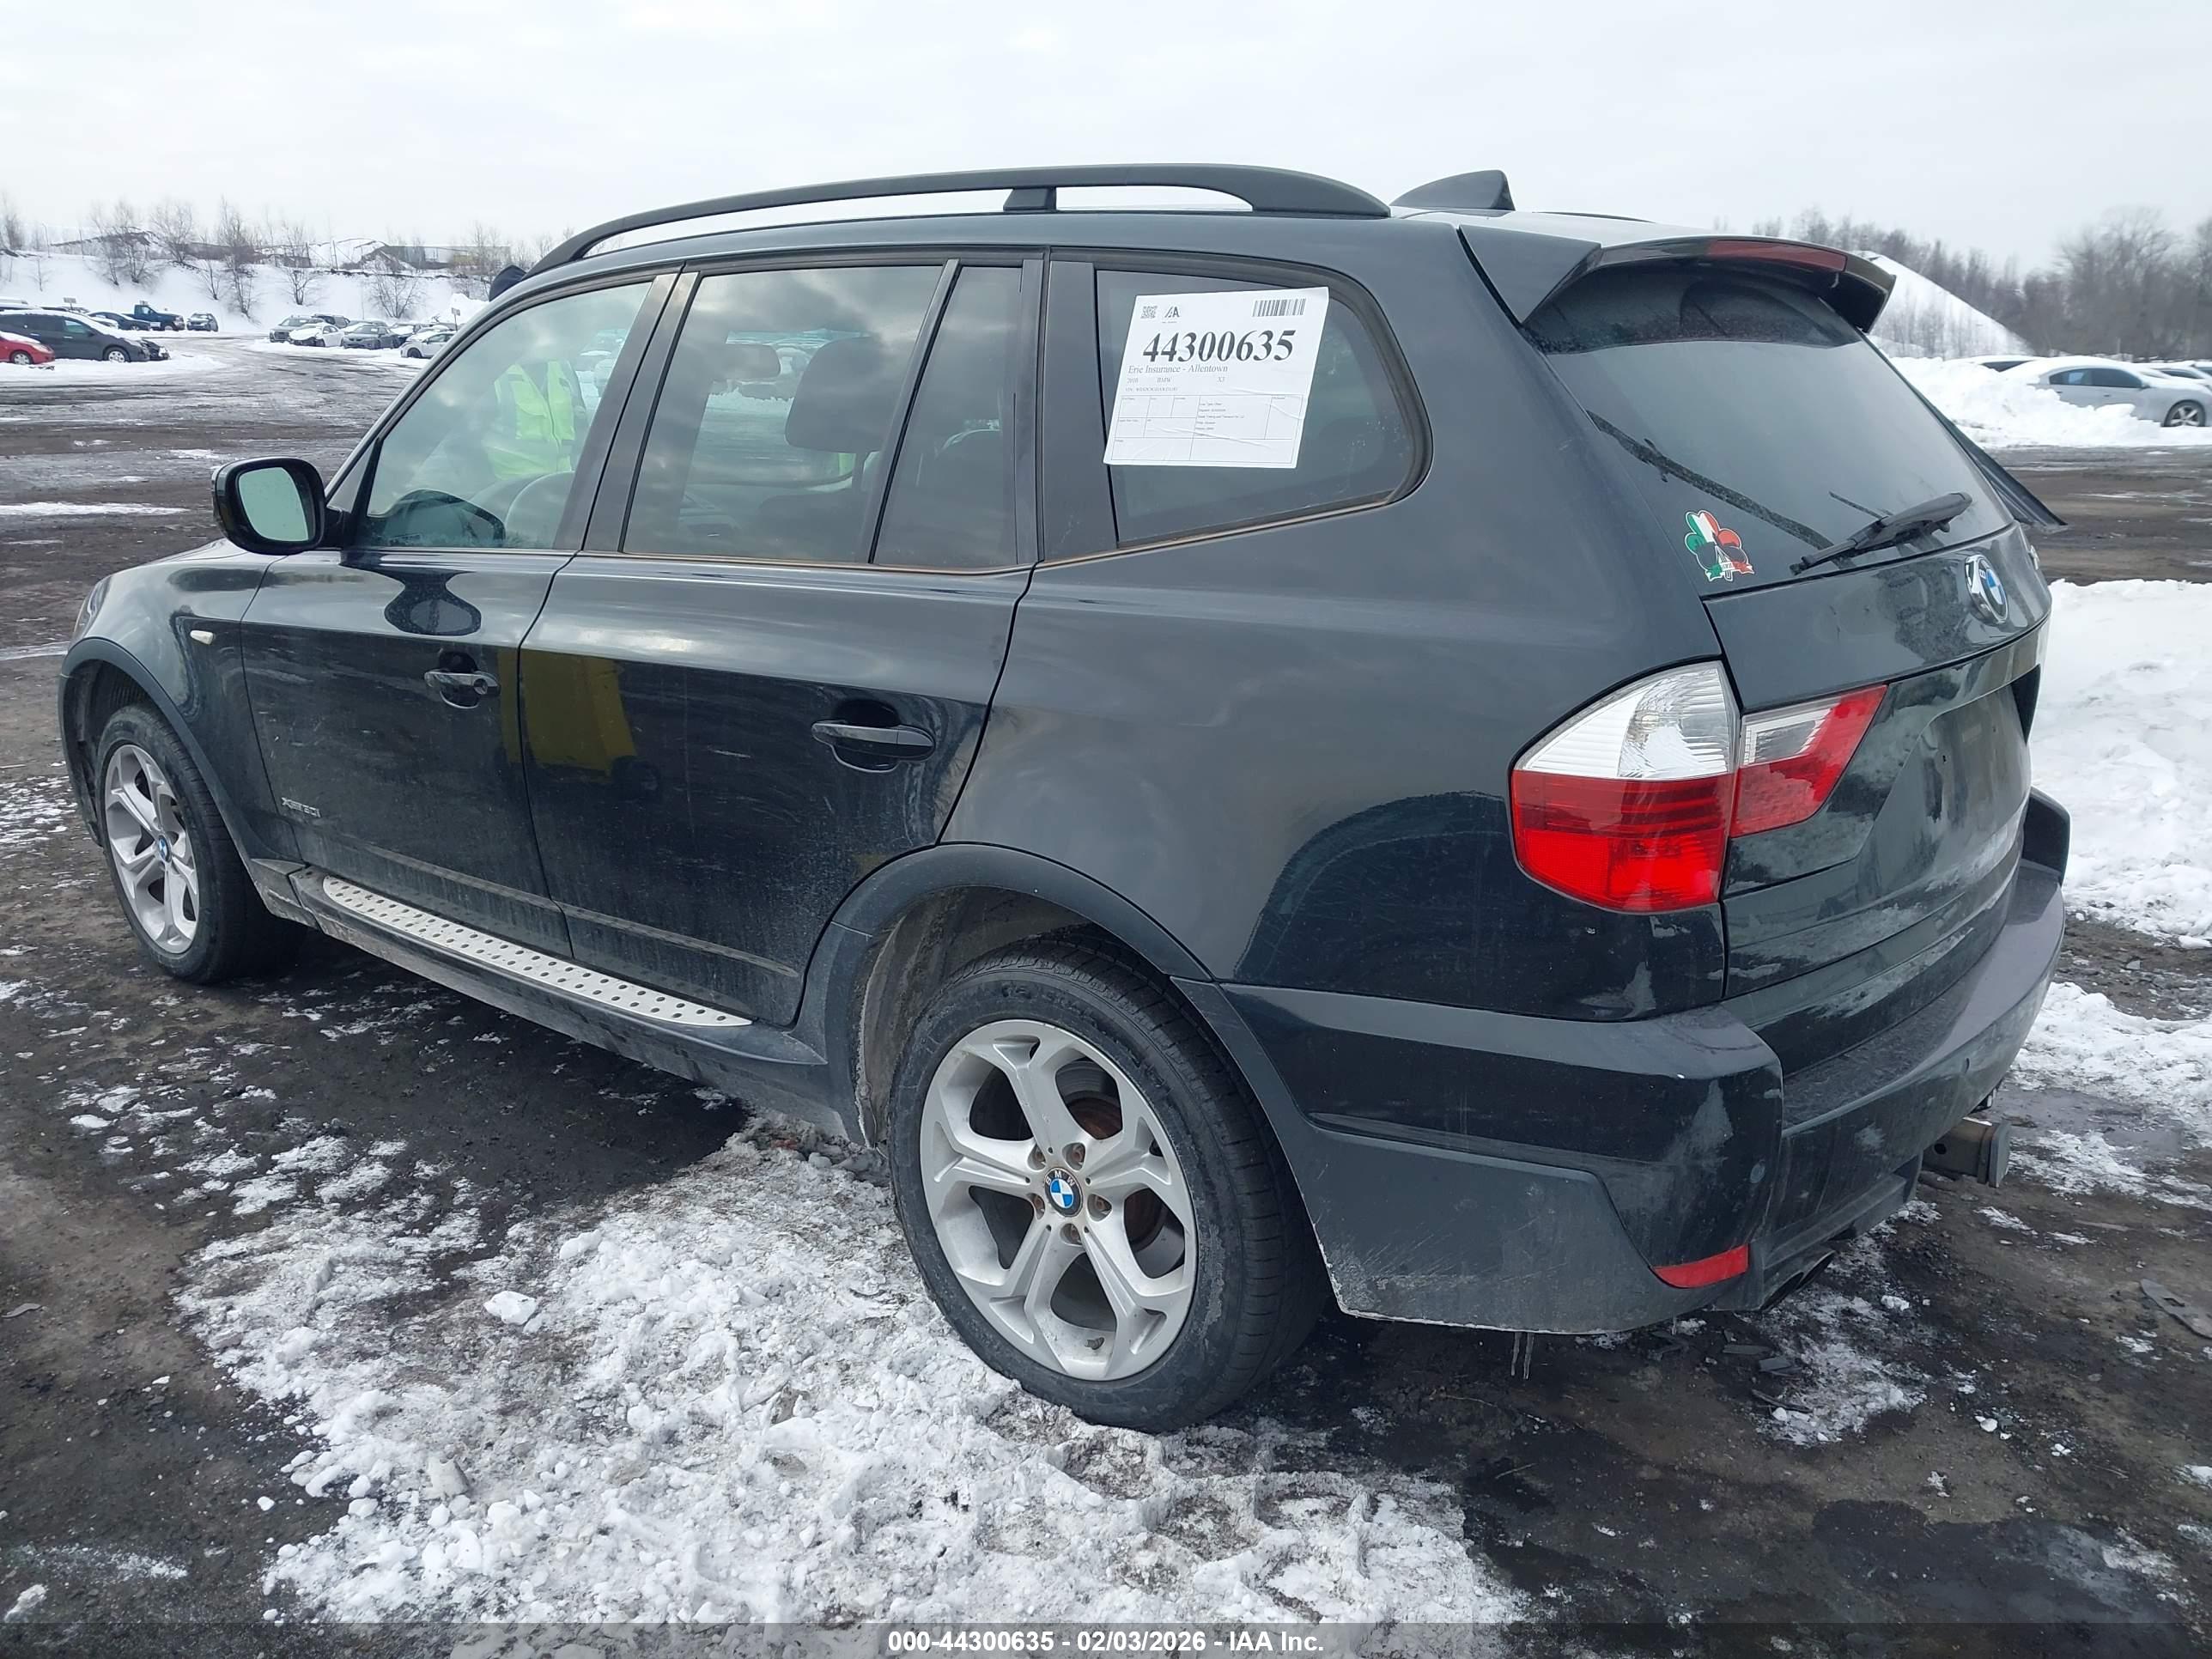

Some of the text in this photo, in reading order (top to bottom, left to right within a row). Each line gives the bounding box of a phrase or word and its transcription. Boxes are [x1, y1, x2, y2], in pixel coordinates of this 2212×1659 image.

[1143, 330, 1296, 362] 44300635
[1128, 365, 1143, 374] Erie
[1145, 364, 1182, 374] Insurance
[1188, 363, 1229, 373] Allentown
[1045, 1170, 1076, 1186] BMW
